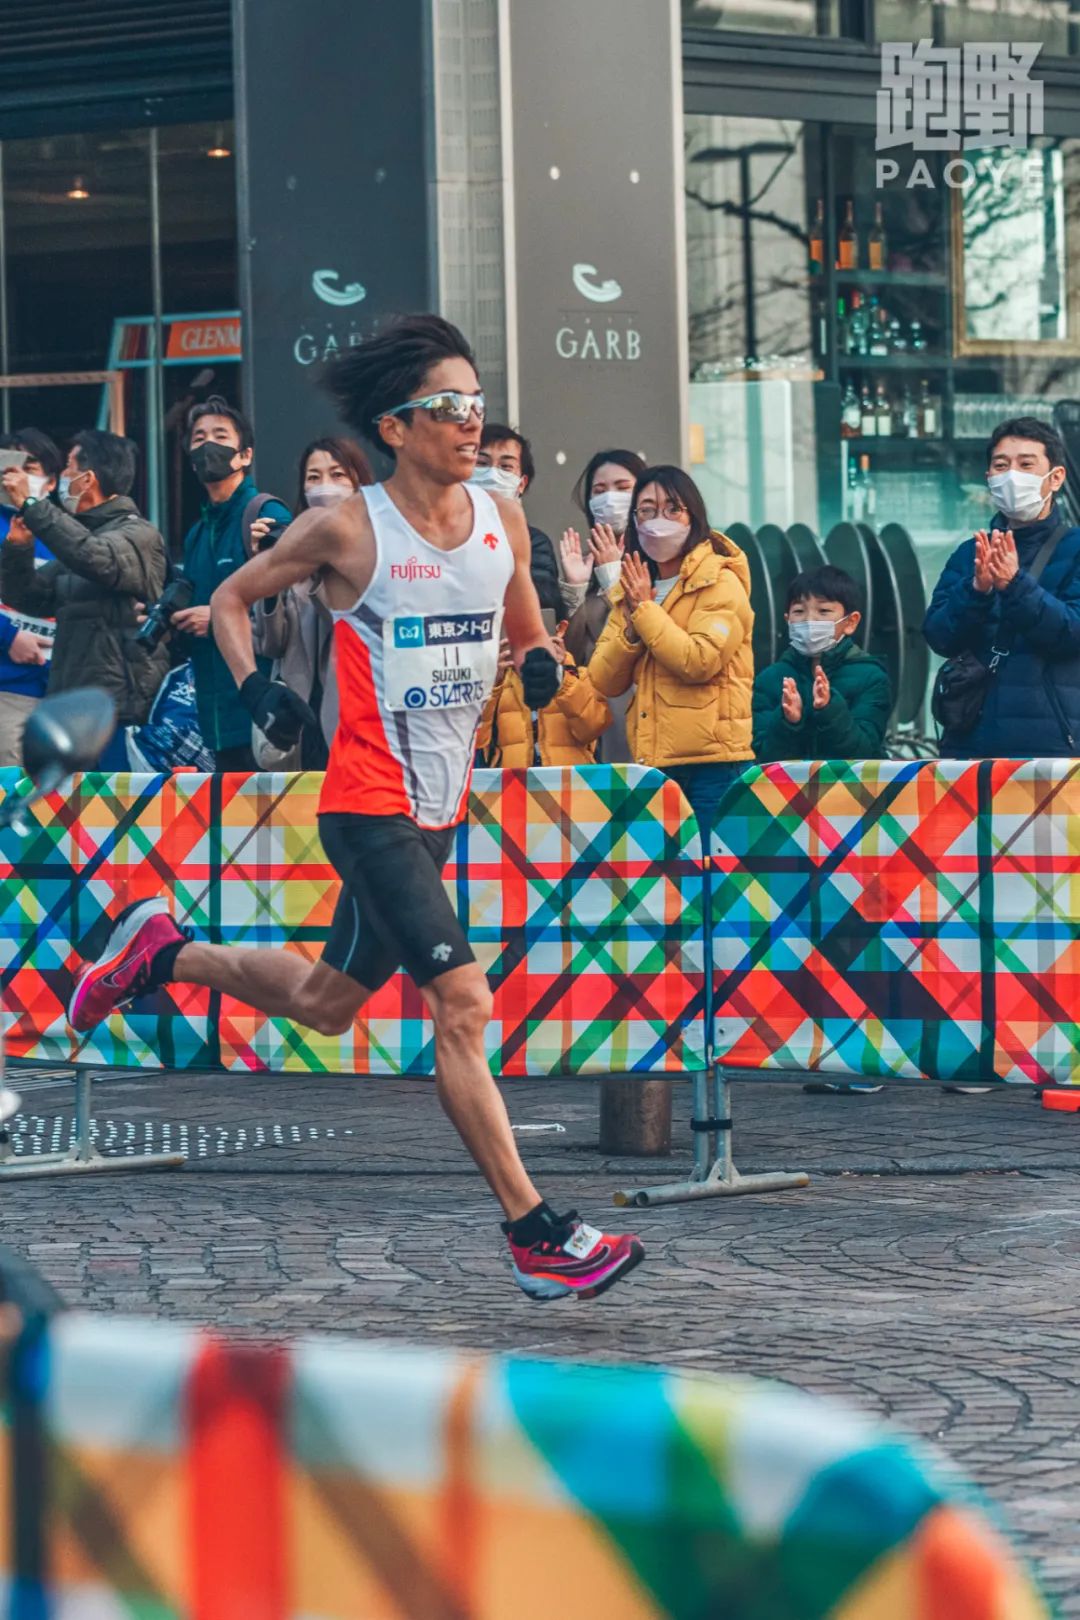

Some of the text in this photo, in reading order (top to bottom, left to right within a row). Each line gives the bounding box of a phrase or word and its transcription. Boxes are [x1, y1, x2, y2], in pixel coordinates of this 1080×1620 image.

[293, 333, 372, 366] GA
[555, 327, 642, 360] GARB
[390, 557, 442, 583] FUJITSU
[426, 619, 491, 639] 東京メトロ
[442, 646, 460, 667] 11
[431, 667, 472, 683] SUZUKI
